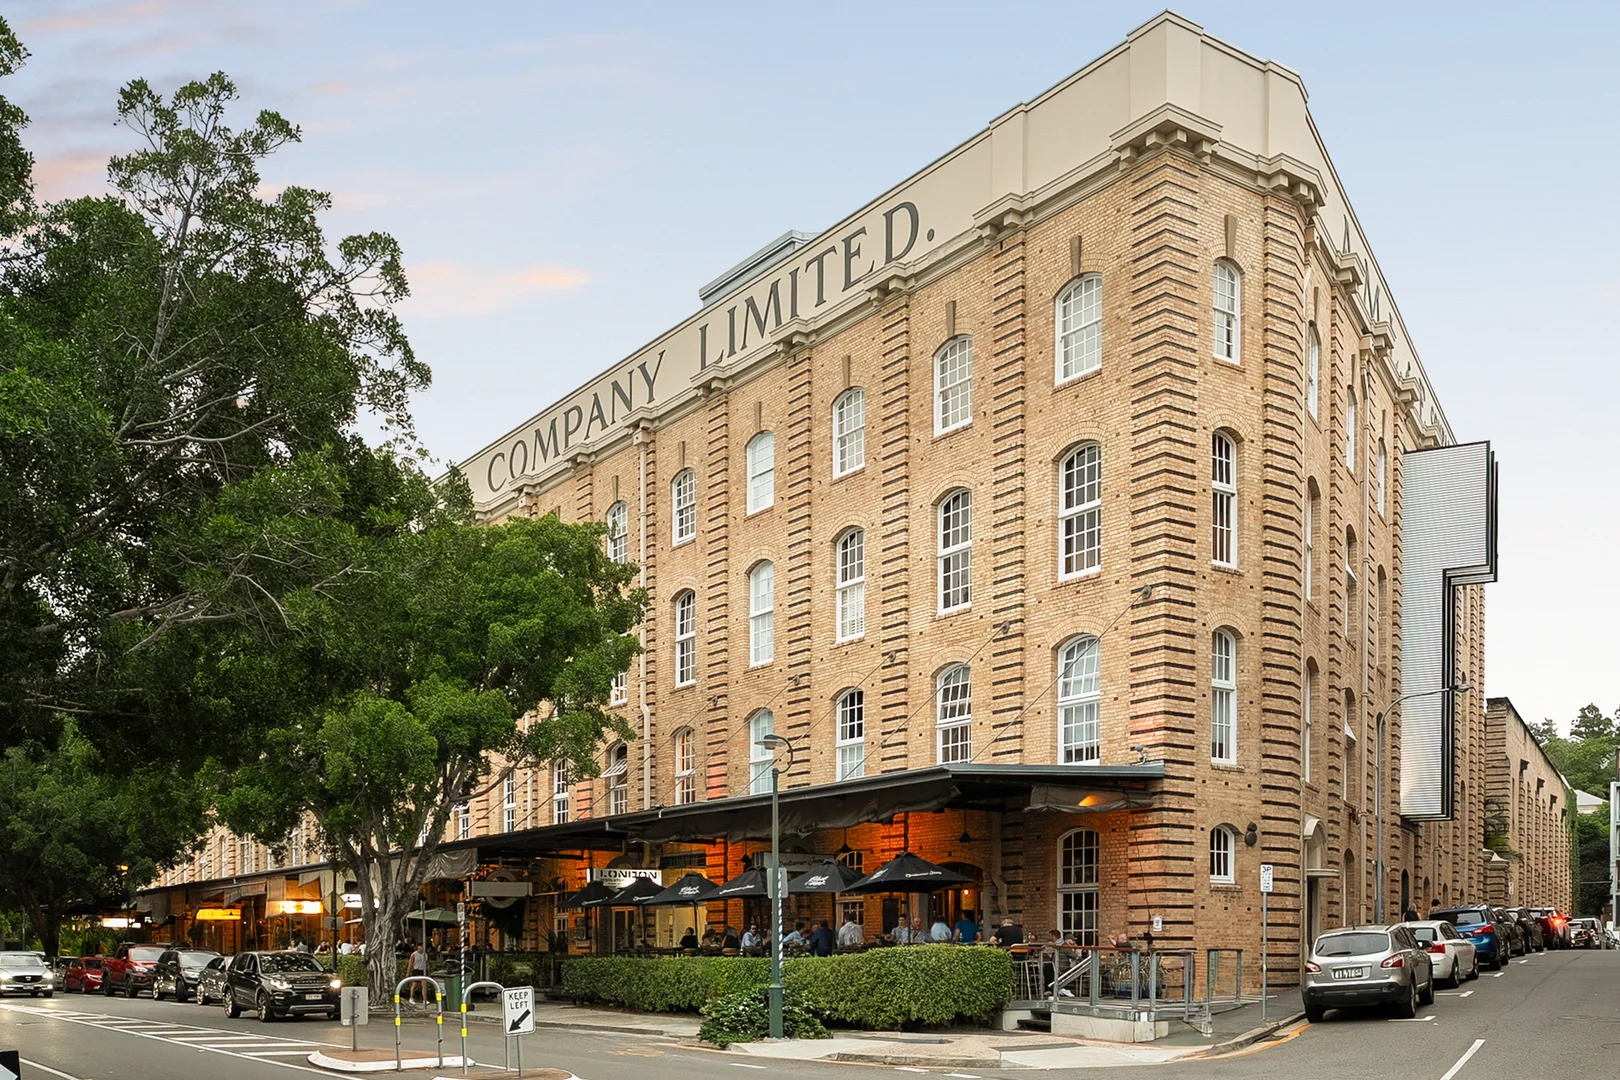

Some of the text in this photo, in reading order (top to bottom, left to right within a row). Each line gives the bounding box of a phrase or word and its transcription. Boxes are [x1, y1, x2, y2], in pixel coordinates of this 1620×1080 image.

[487, 201, 935, 493] COMPANY LIMITED.
[600, 869, 657, 879] LONDON
[508, 991, 529, 1001] KEEP
[510, 1001, 528, 1010] LEFT
